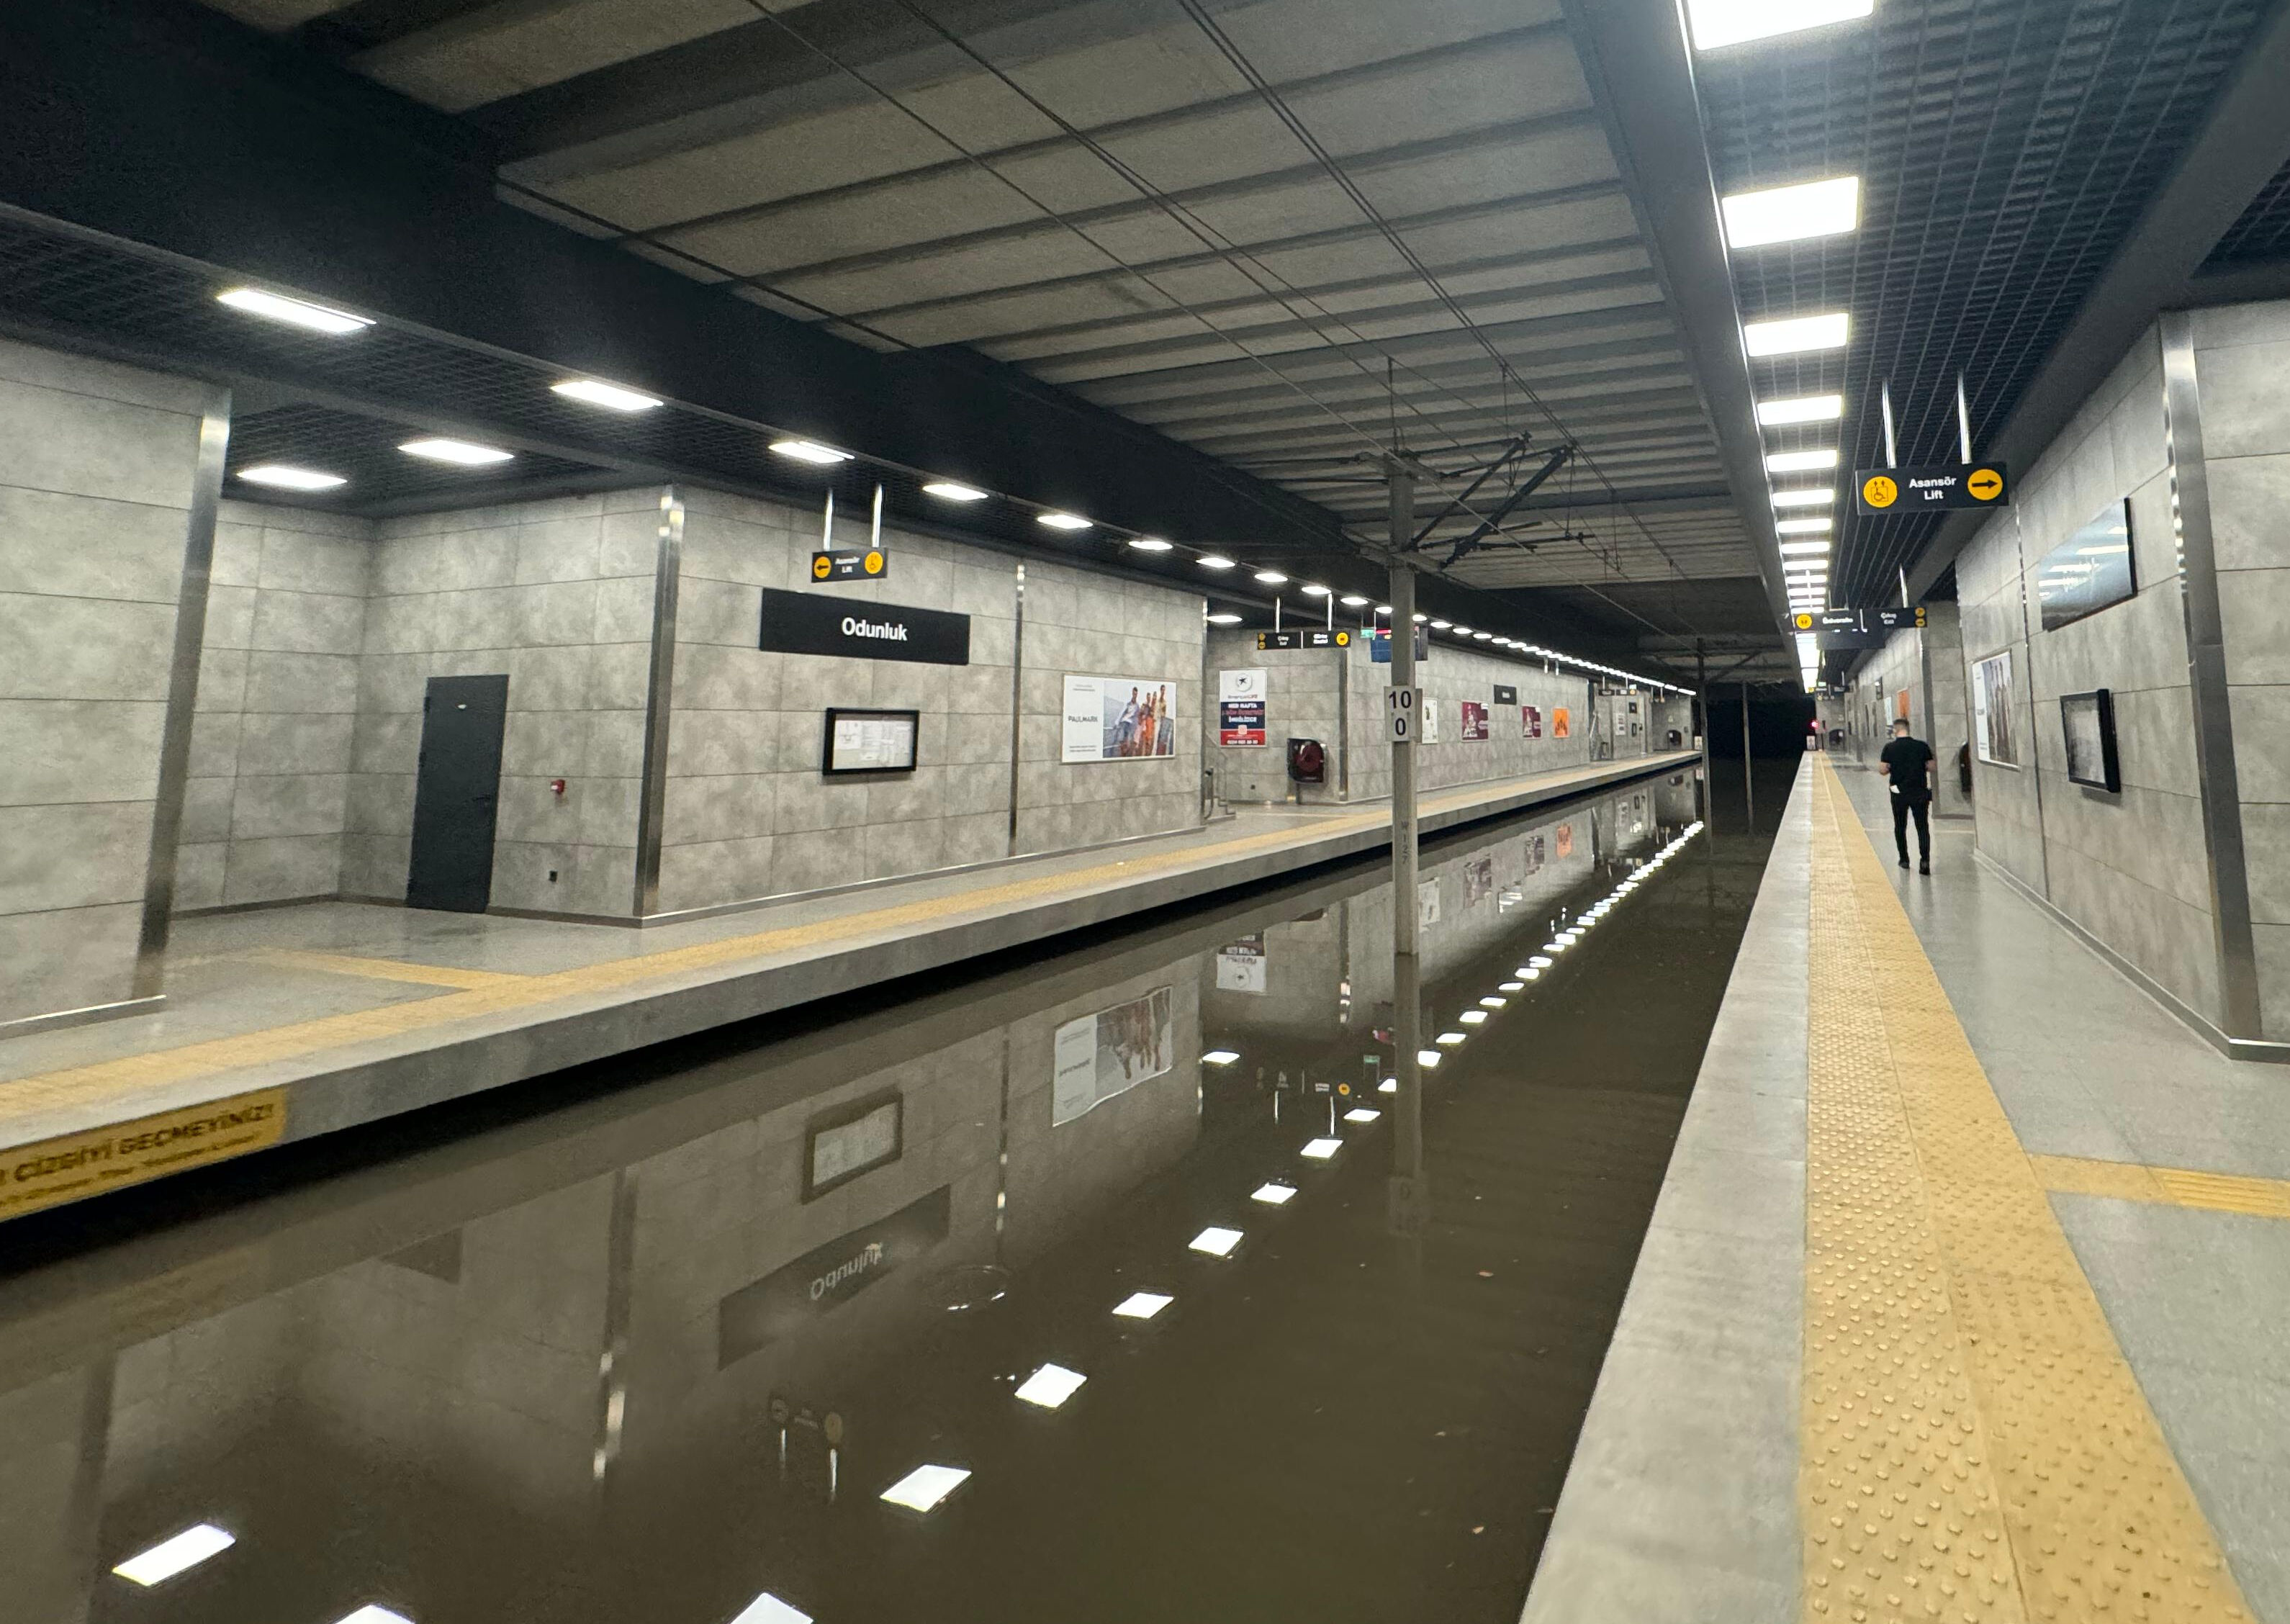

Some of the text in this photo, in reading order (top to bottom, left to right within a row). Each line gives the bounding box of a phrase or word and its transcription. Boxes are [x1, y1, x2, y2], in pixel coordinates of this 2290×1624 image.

[1909, 477, 1957, 488] Asansör
[1924, 490, 1944, 500] Lift
[841, 617, 908, 641] Odunluk
[1389, 690, 1412, 709] 10
[1395, 717, 1407, 736] 0
